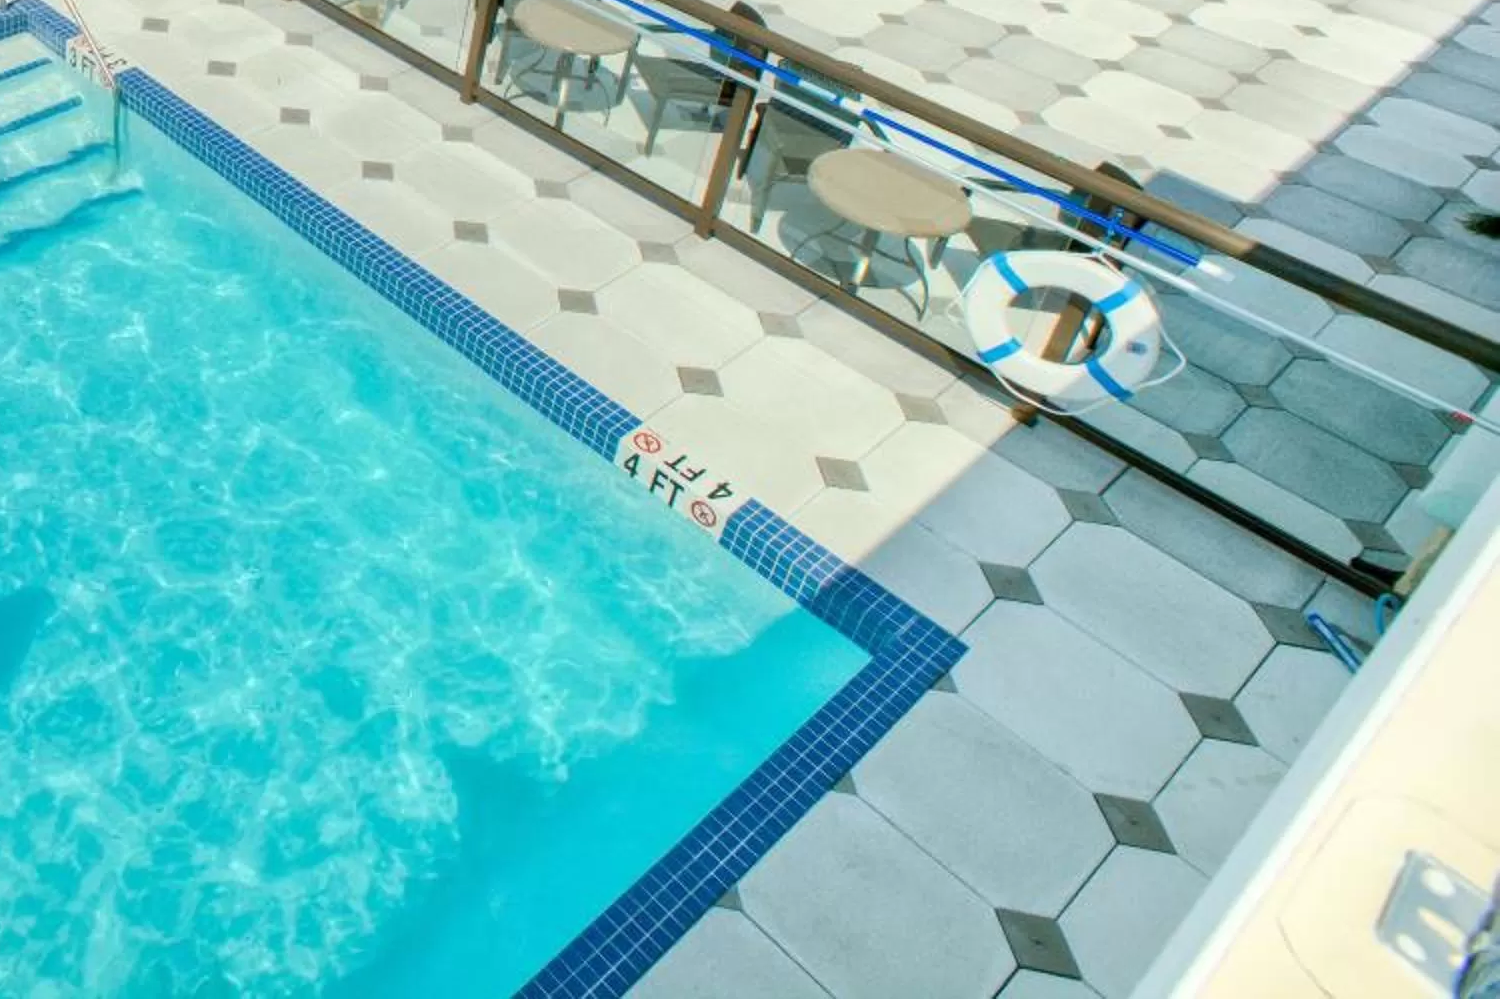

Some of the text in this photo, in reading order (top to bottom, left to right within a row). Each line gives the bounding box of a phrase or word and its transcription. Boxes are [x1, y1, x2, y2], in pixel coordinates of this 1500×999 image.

[623, 452, 685, 509] 4 FT
[663, 454, 734, 500] 4 FT
